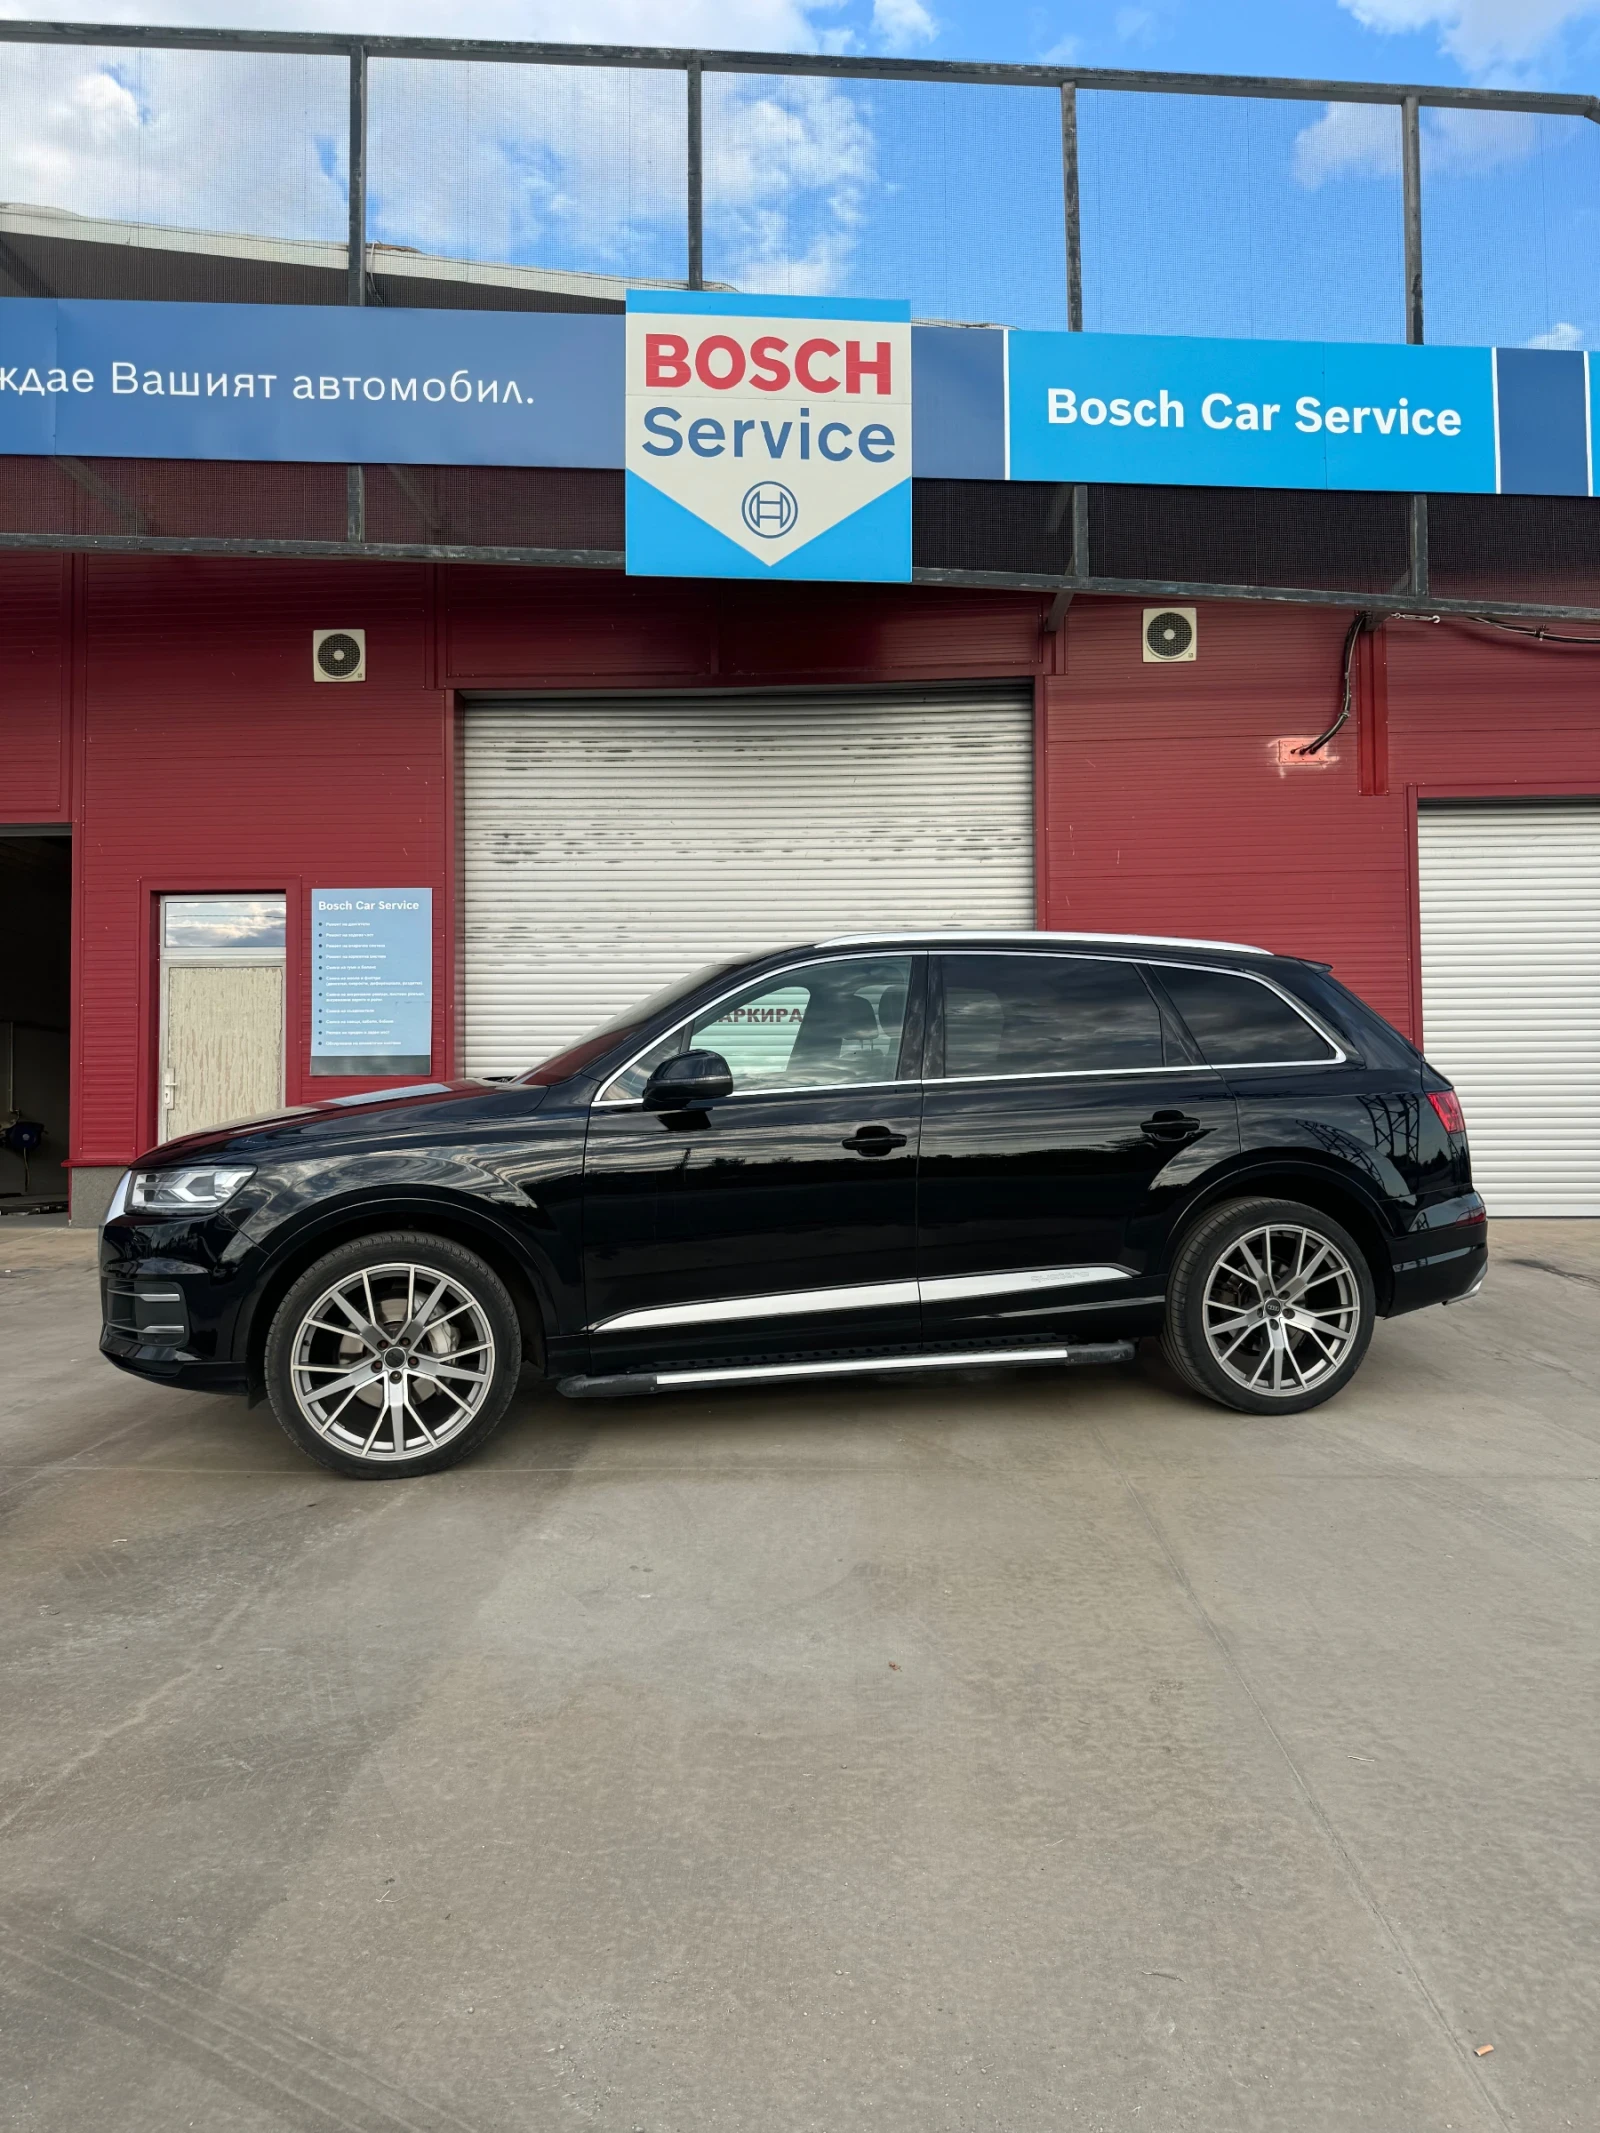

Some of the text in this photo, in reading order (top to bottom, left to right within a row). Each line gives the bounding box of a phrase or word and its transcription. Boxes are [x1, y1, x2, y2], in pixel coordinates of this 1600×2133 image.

[113, 363, 276, 397] Вашият
[293, 370, 533, 404] автомобил.
[646, 334, 890, 394] BOSCH
[1049, 389, 1460, 435] Bosch Car Service
[643, 408, 894, 463] Service
[319, 900, 419, 910] Bosch Car Service
